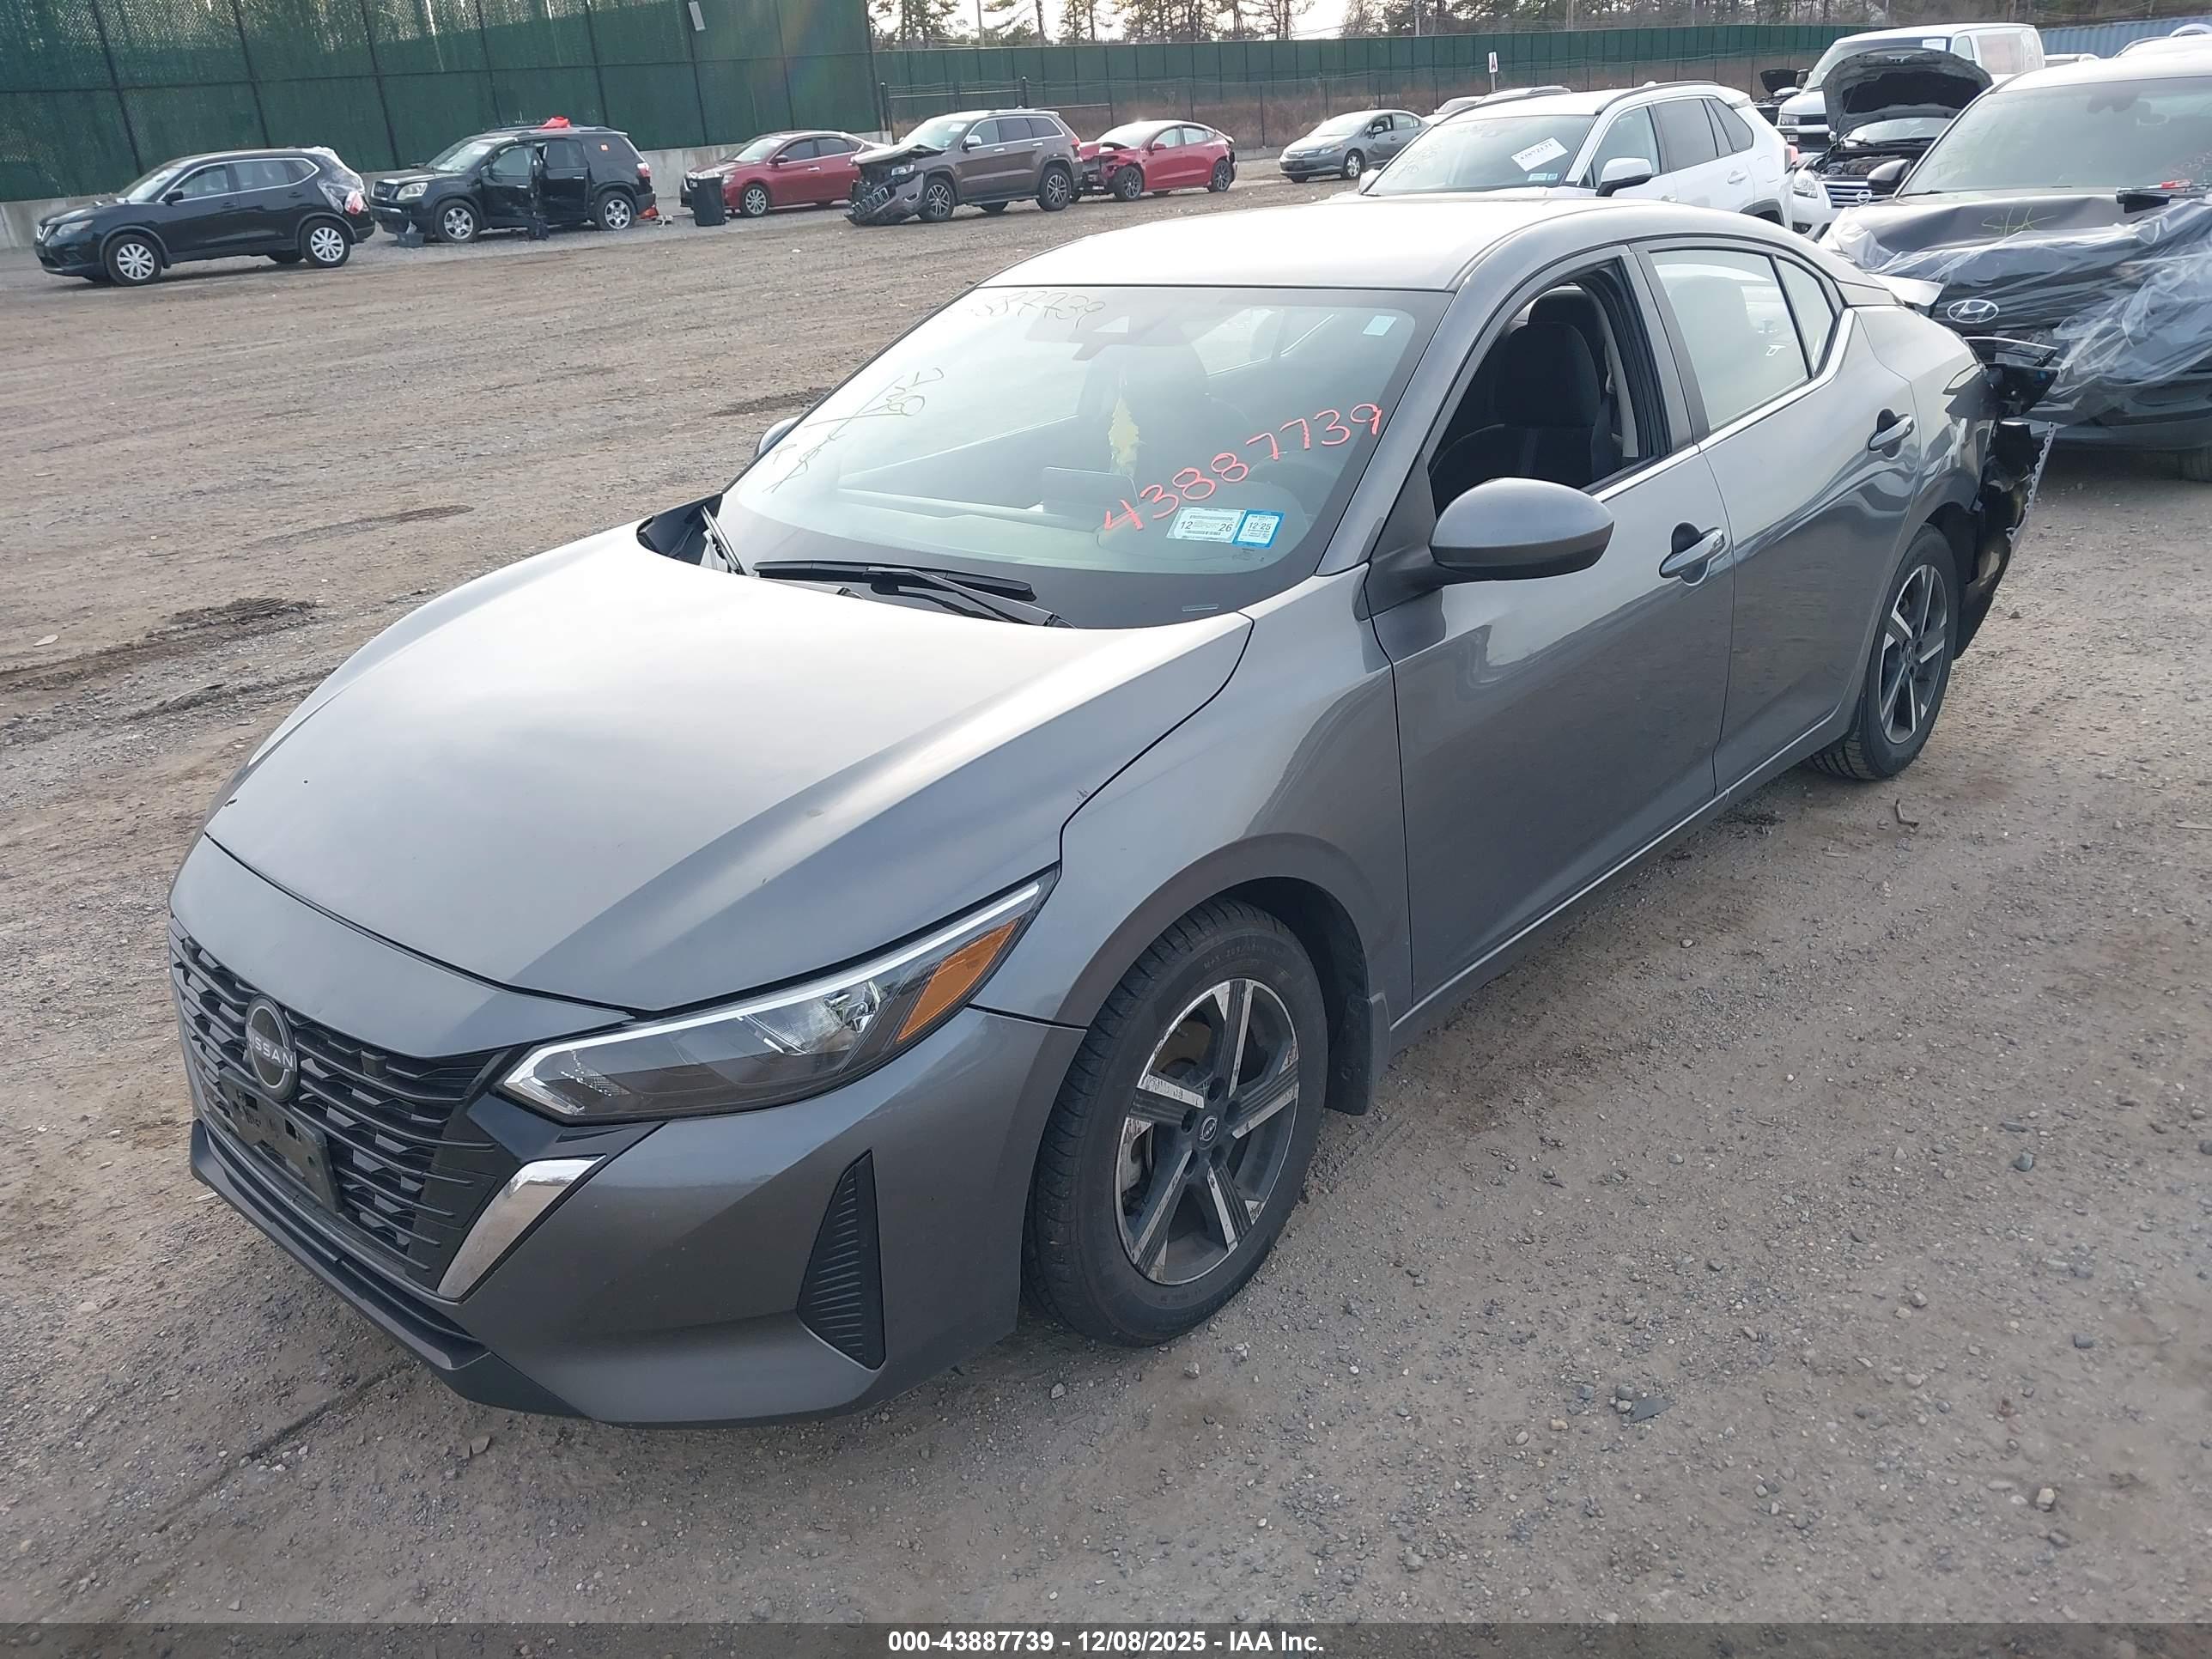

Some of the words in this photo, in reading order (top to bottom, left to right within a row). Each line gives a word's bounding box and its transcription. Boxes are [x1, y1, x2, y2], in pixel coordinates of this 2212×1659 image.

[1104, 404, 1382, 531] 43887739
[1180, 520, 1194, 530] 12
[1218, 523, 1234, 532] 26
